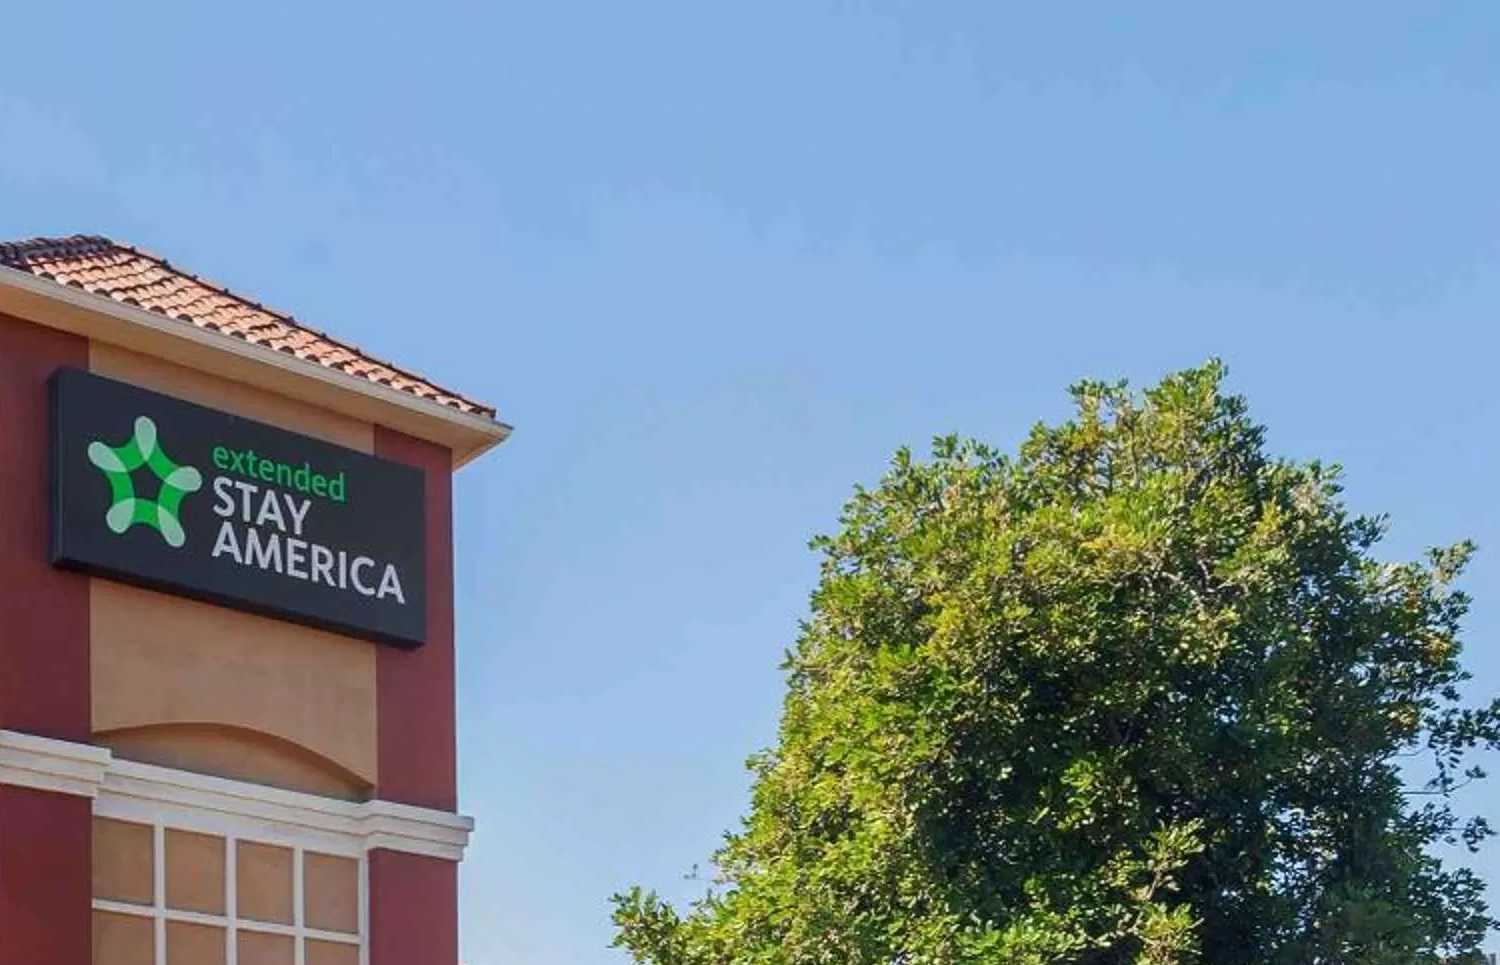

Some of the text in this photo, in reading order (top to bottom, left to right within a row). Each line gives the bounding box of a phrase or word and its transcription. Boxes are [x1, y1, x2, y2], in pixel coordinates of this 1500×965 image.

[212, 443, 346, 502] extended
[212, 476, 312, 536] STAY
[211, 522, 406, 605] AMERICA
